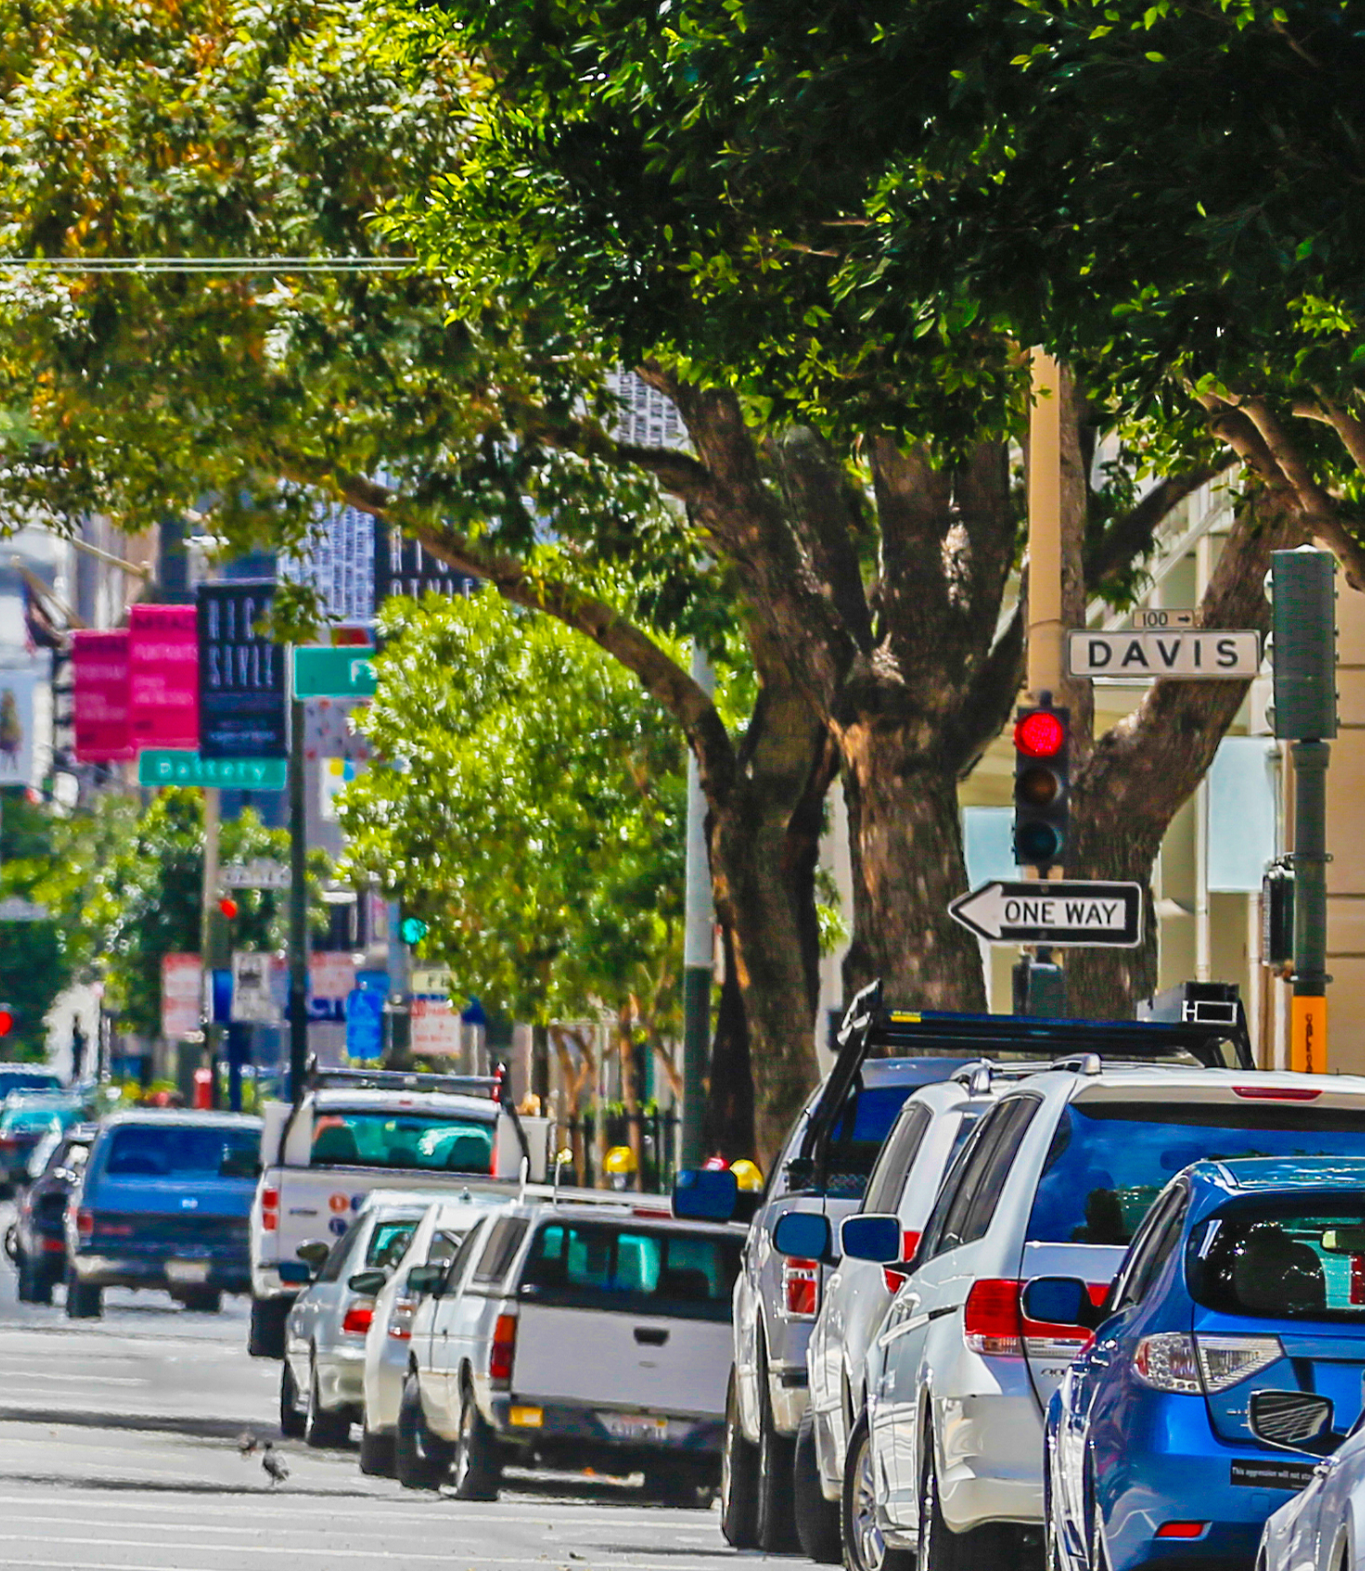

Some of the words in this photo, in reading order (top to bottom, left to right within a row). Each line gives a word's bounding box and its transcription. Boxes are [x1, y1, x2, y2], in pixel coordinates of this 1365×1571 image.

[1142, 612, 1169, 626] 100
[1088, 638, 1238, 668] DAVIS
[1004, 900, 1055, 924] ONE
[1065, 902, 1117, 925] WAY
